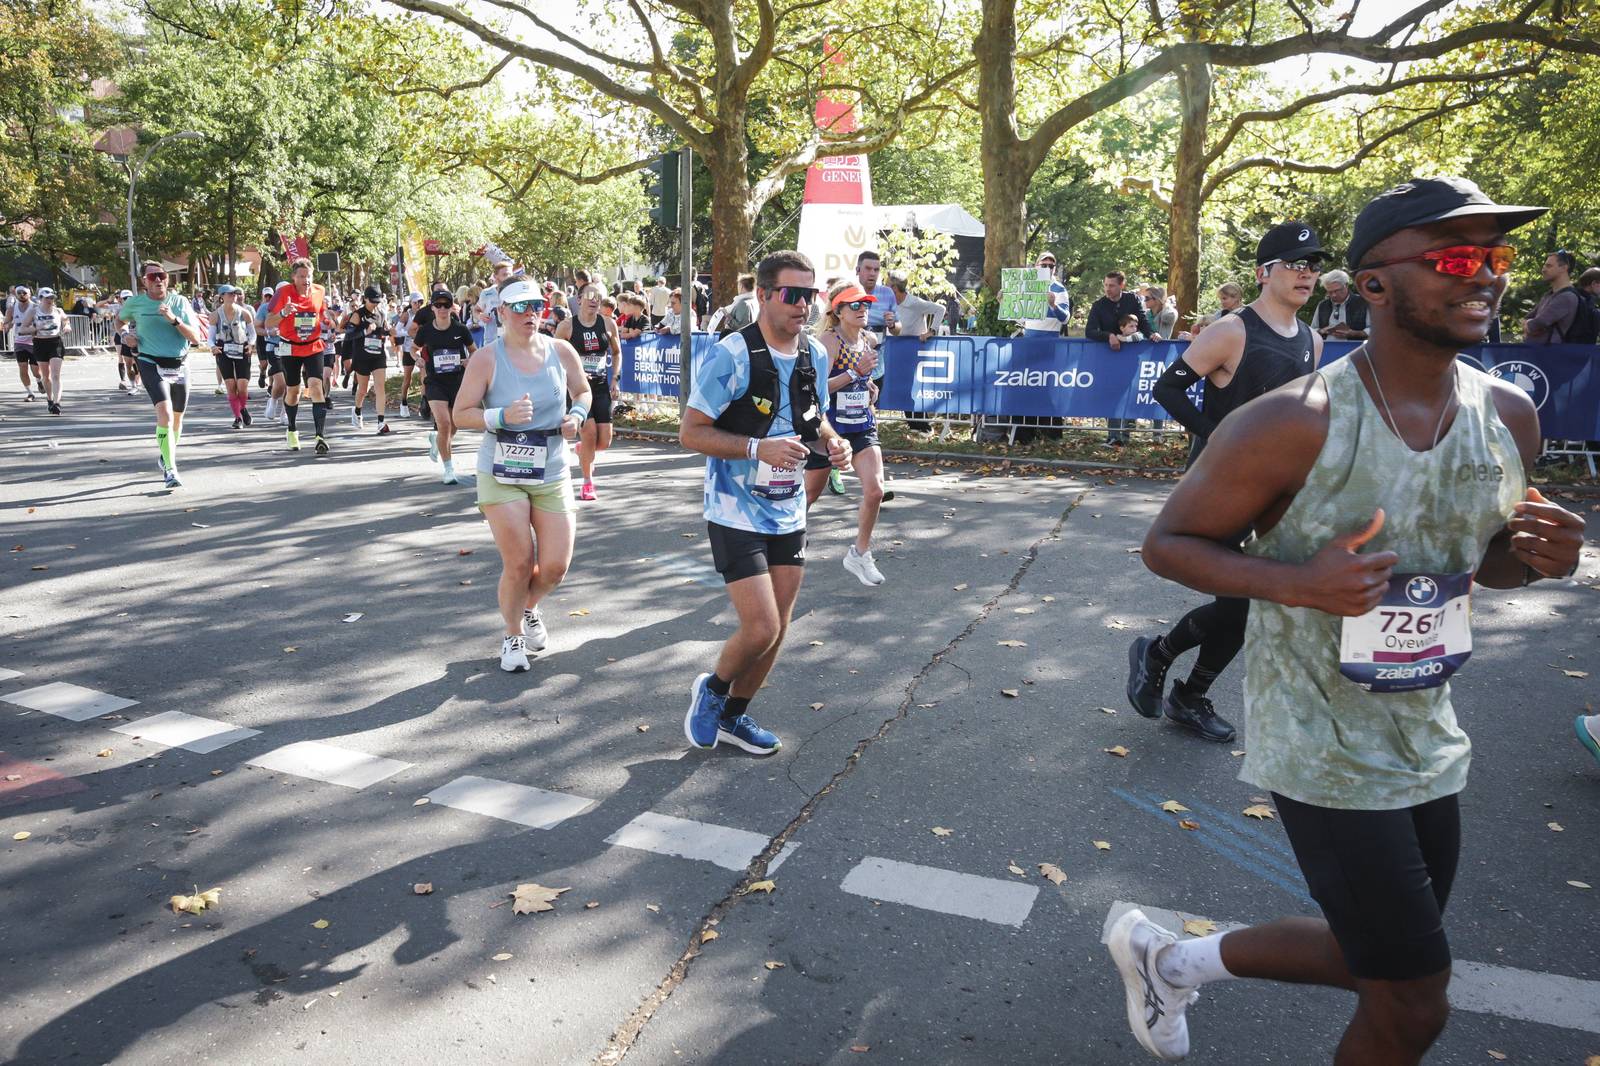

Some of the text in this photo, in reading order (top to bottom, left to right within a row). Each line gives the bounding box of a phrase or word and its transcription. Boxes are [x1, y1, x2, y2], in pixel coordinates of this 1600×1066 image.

[824, 253, 859, 271] DV
[583, 332, 598, 340] IDA
[635, 346, 665, 362] BMW
[634, 361, 664, 373] BERLIN
[1140, 361, 1174, 378] BM
[1491, 363, 1541, 381] BMW
[995, 367, 1094, 388] zalando
[917, 389, 953, 400] ABBOTT
[505, 445, 536, 457] 72772
[1457, 460, 1504, 483] ciele
[1375, 662, 1443, 680] zalando
